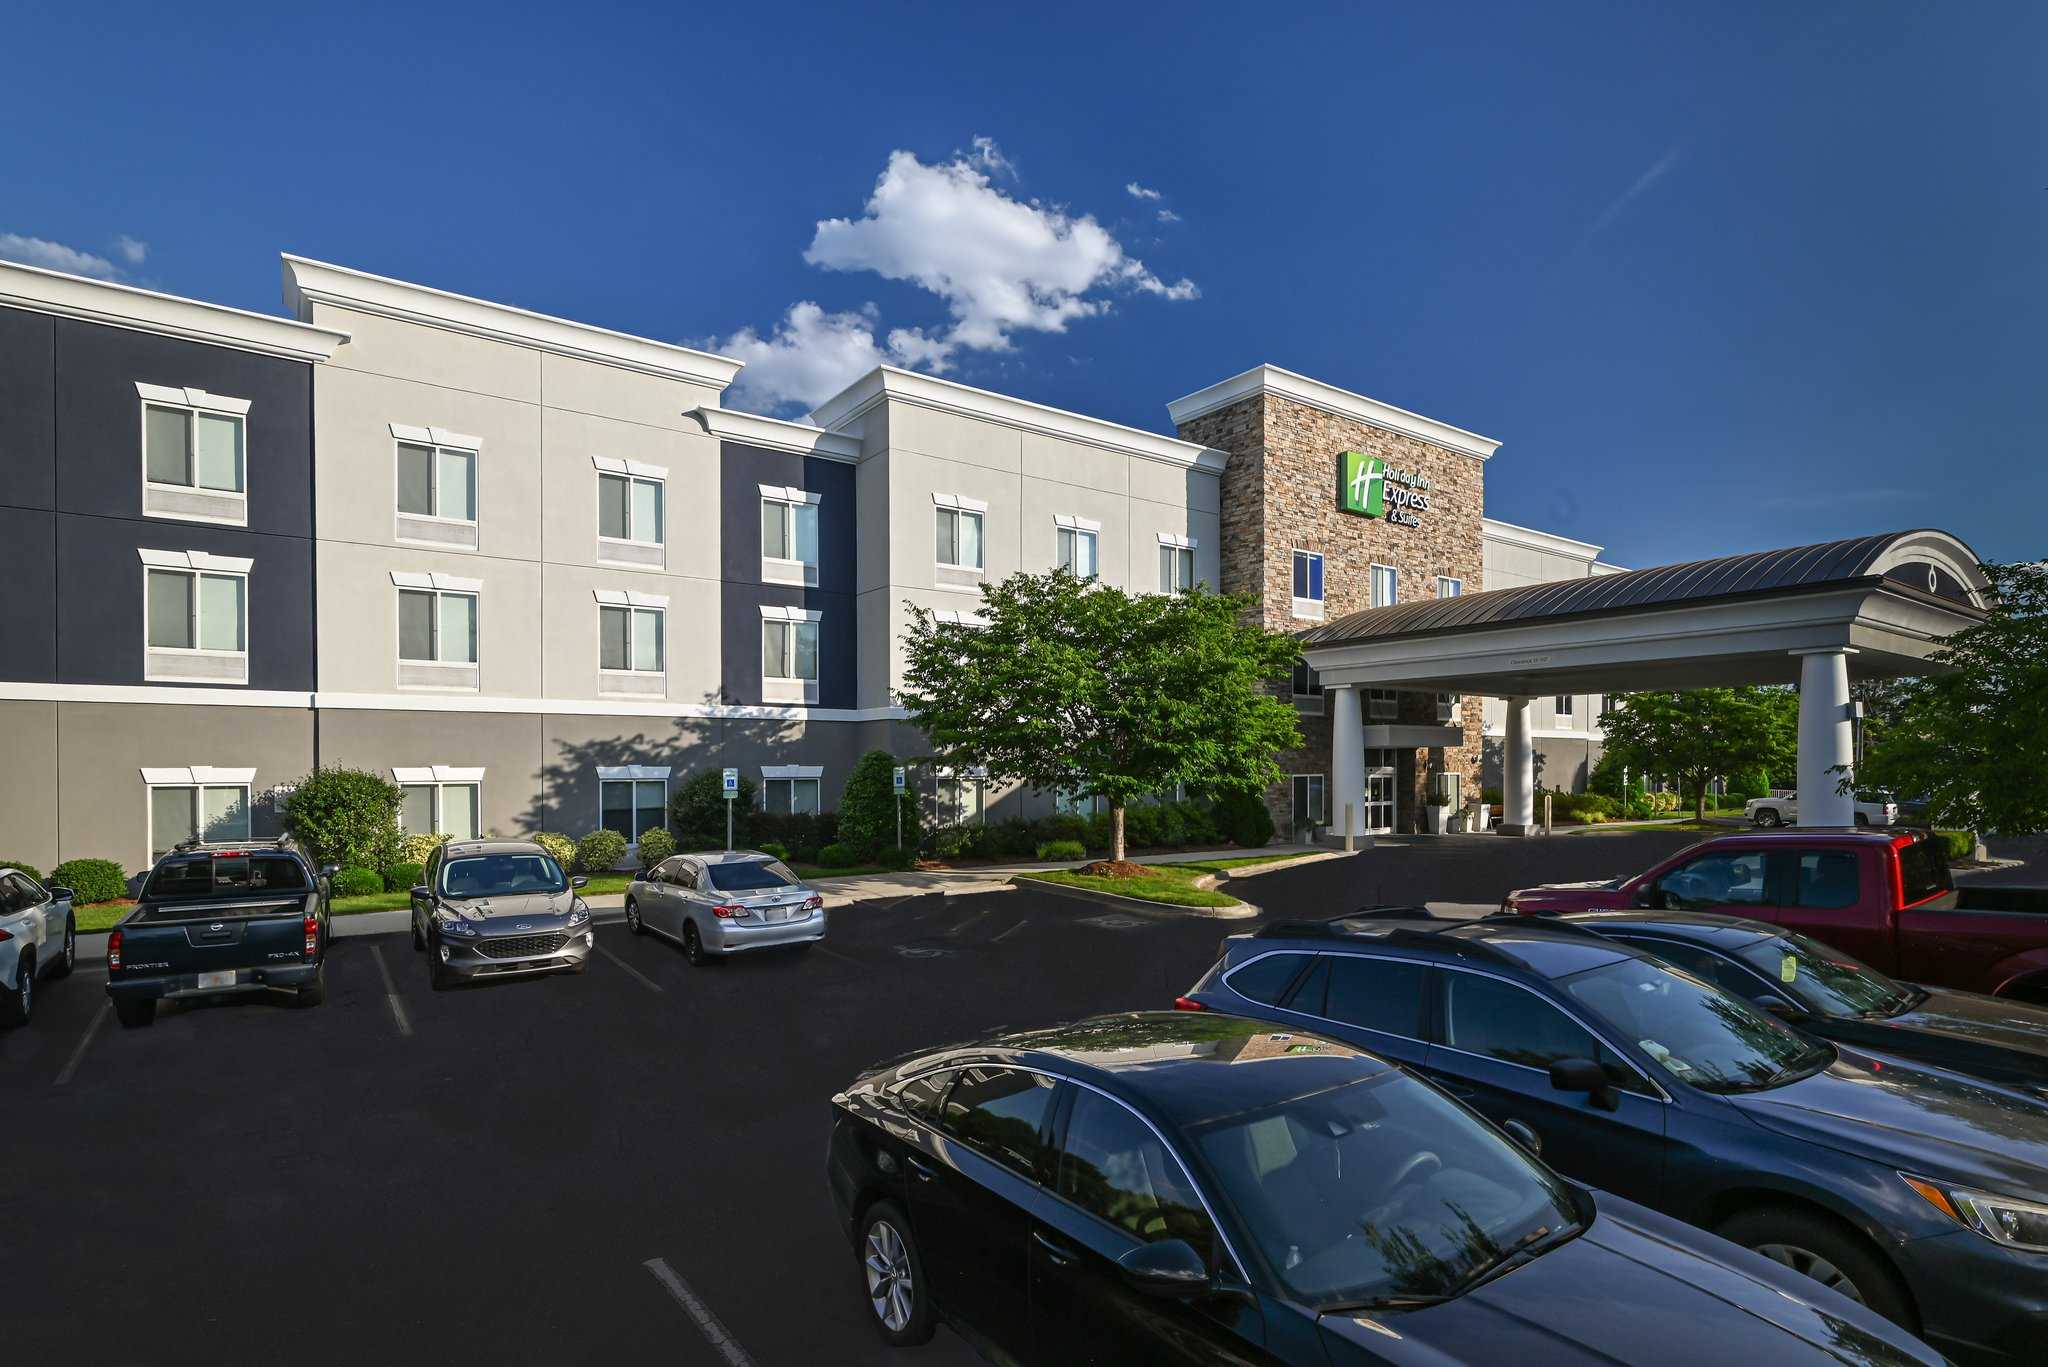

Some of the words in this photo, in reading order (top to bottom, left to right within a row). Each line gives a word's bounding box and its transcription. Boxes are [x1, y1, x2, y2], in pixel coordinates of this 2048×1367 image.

[1351, 460, 1383, 509] H
[1383, 463, 1416, 488] Holiday
[1383, 481, 1430, 511] Express
[1391, 509, 1398, 523] &
[1399, 511, 1421, 528] Suites
[125, 961, 169, 970] FRONTIER
